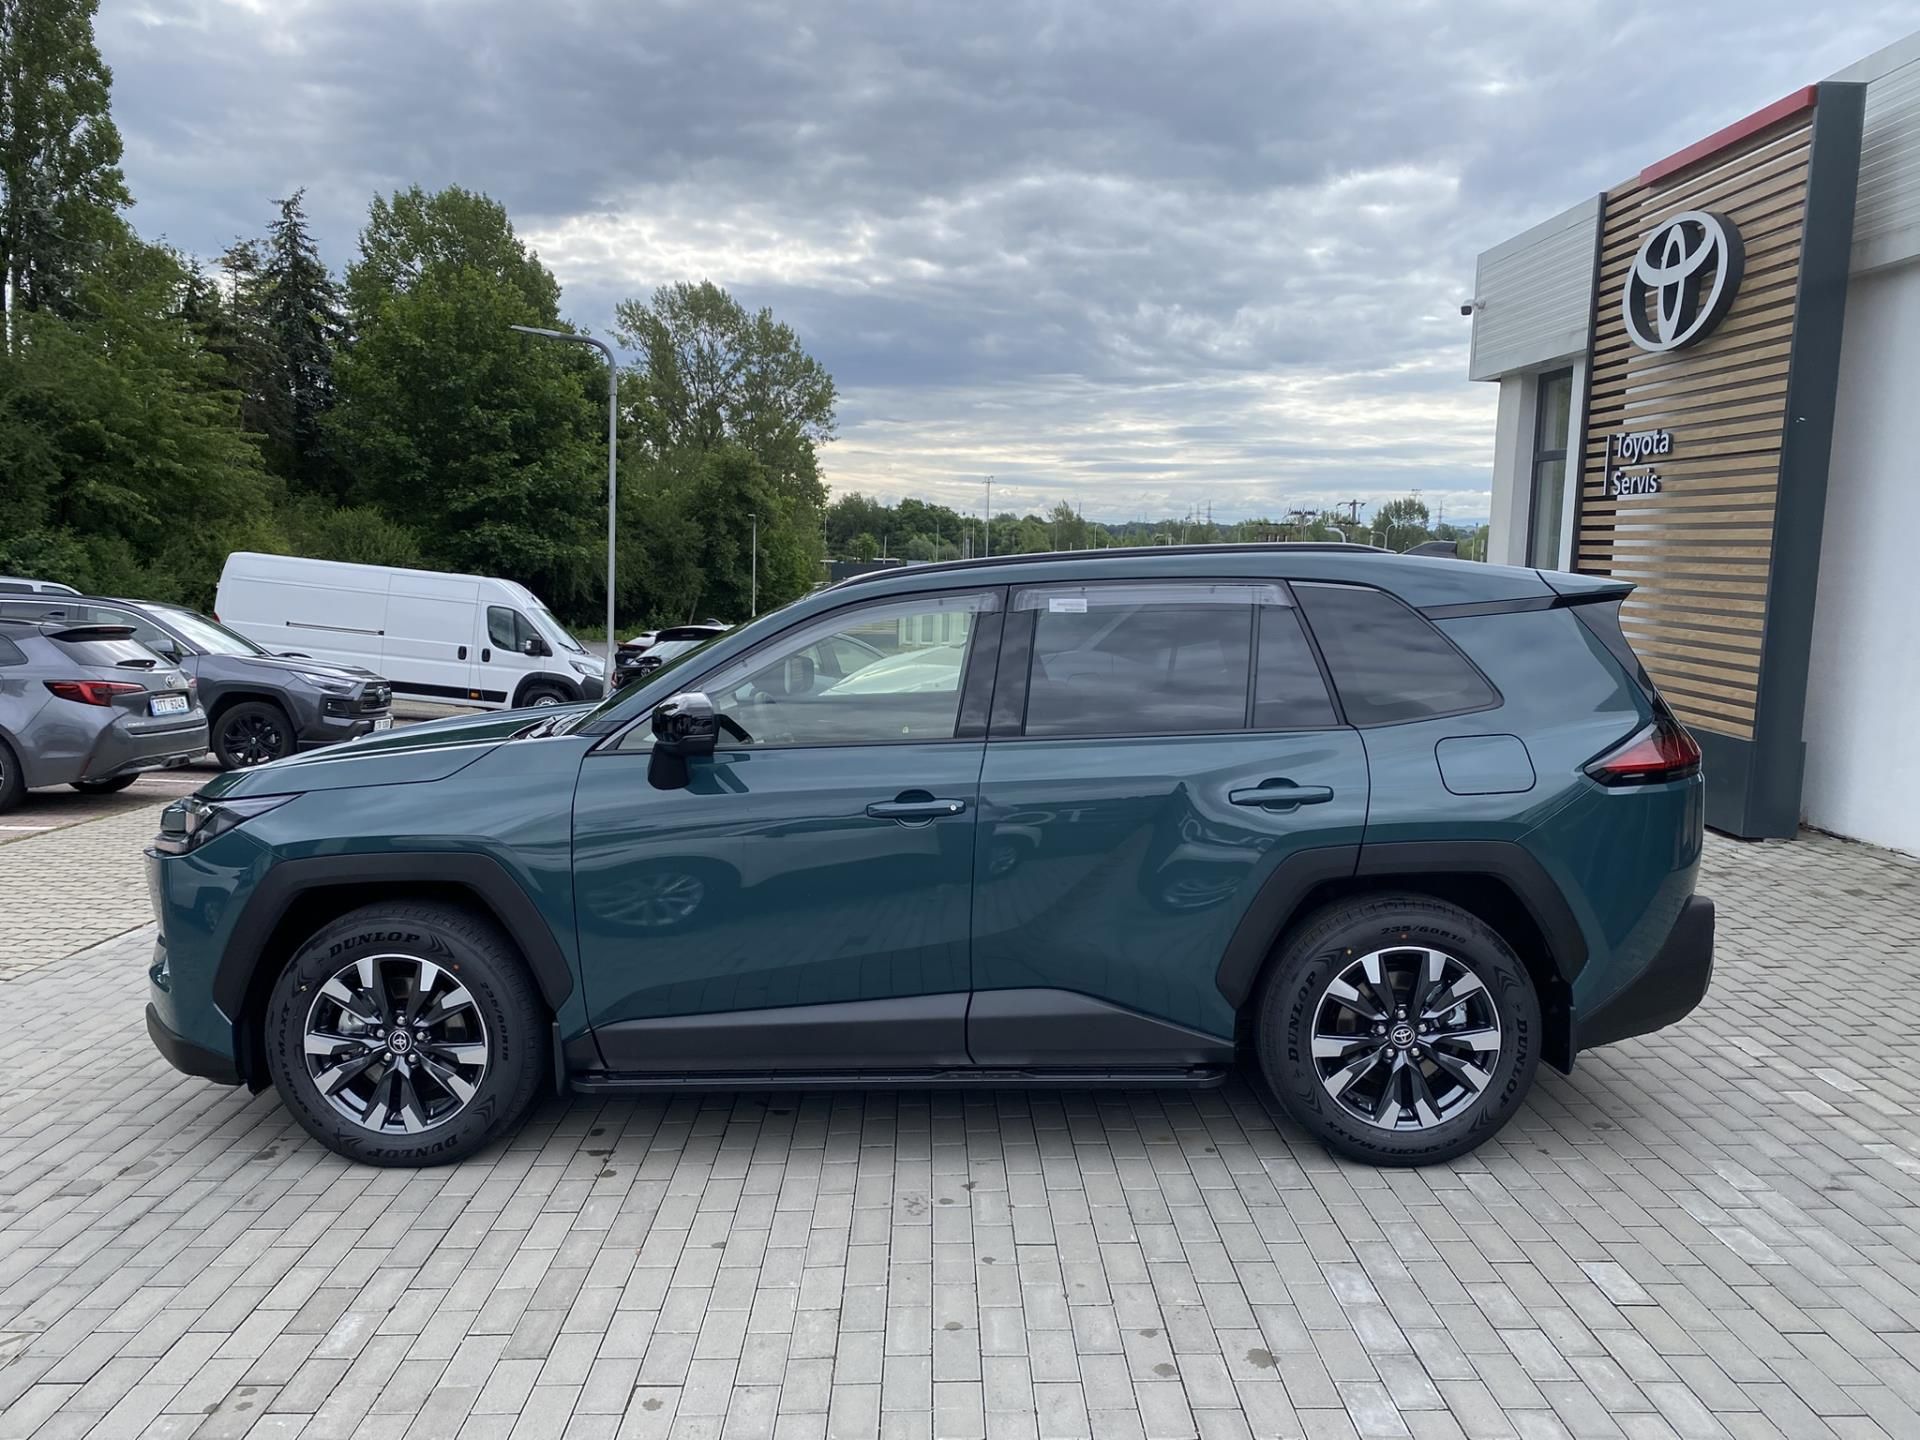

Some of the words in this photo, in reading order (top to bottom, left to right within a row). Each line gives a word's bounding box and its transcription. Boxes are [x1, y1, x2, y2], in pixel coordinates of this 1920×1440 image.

[1616, 431, 1670, 464] Toyota
[1612, 468, 1657, 495] Servis
[329, 931, 420, 957] DUNLOP
[1287, 971, 1316, 1064] DUNLOP
[1501, 1018, 1528, 1106] DUNLOP
[367, 1133, 459, 1159] DUNLOP
